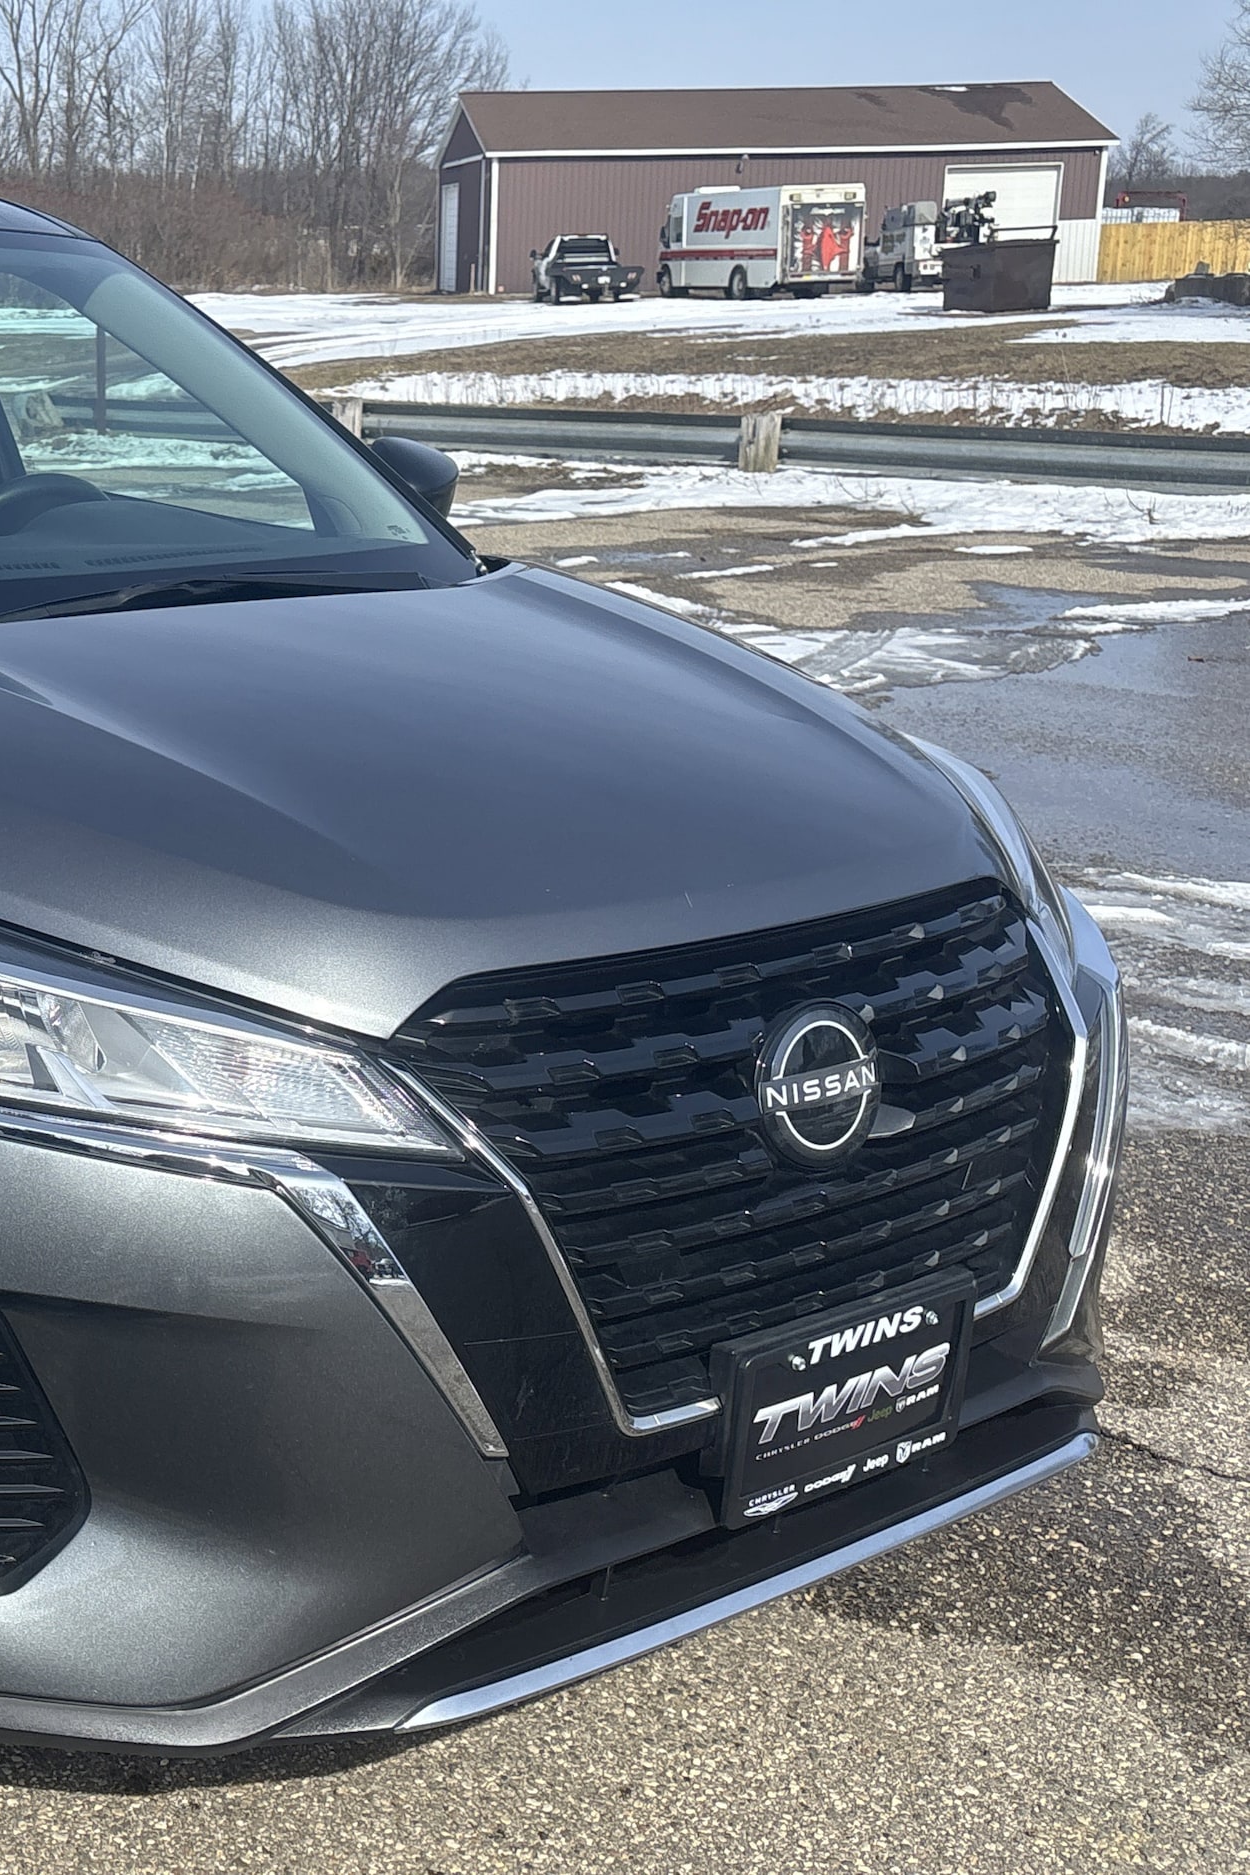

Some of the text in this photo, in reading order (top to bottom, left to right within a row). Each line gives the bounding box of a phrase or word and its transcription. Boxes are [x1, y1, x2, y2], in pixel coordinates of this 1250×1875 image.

[693, 201, 769, 239] Snap-on
[765, 1062, 876, 1108] NISSAN
[808, 1306, 924, 1365] TWINS
[753, 1342, 950, 1445] TWINS
[755, 1437, 810, 1461] CHRYSLER
[867, 1405, 892, 1424] Jeep
[906, 1384, 940, 1406] RAM
[748, 1484, 796, 1507] CHRYSLER
[863, 1454, 889, 1473] Jeep
[911, 1431, 946, 1453] RAM
